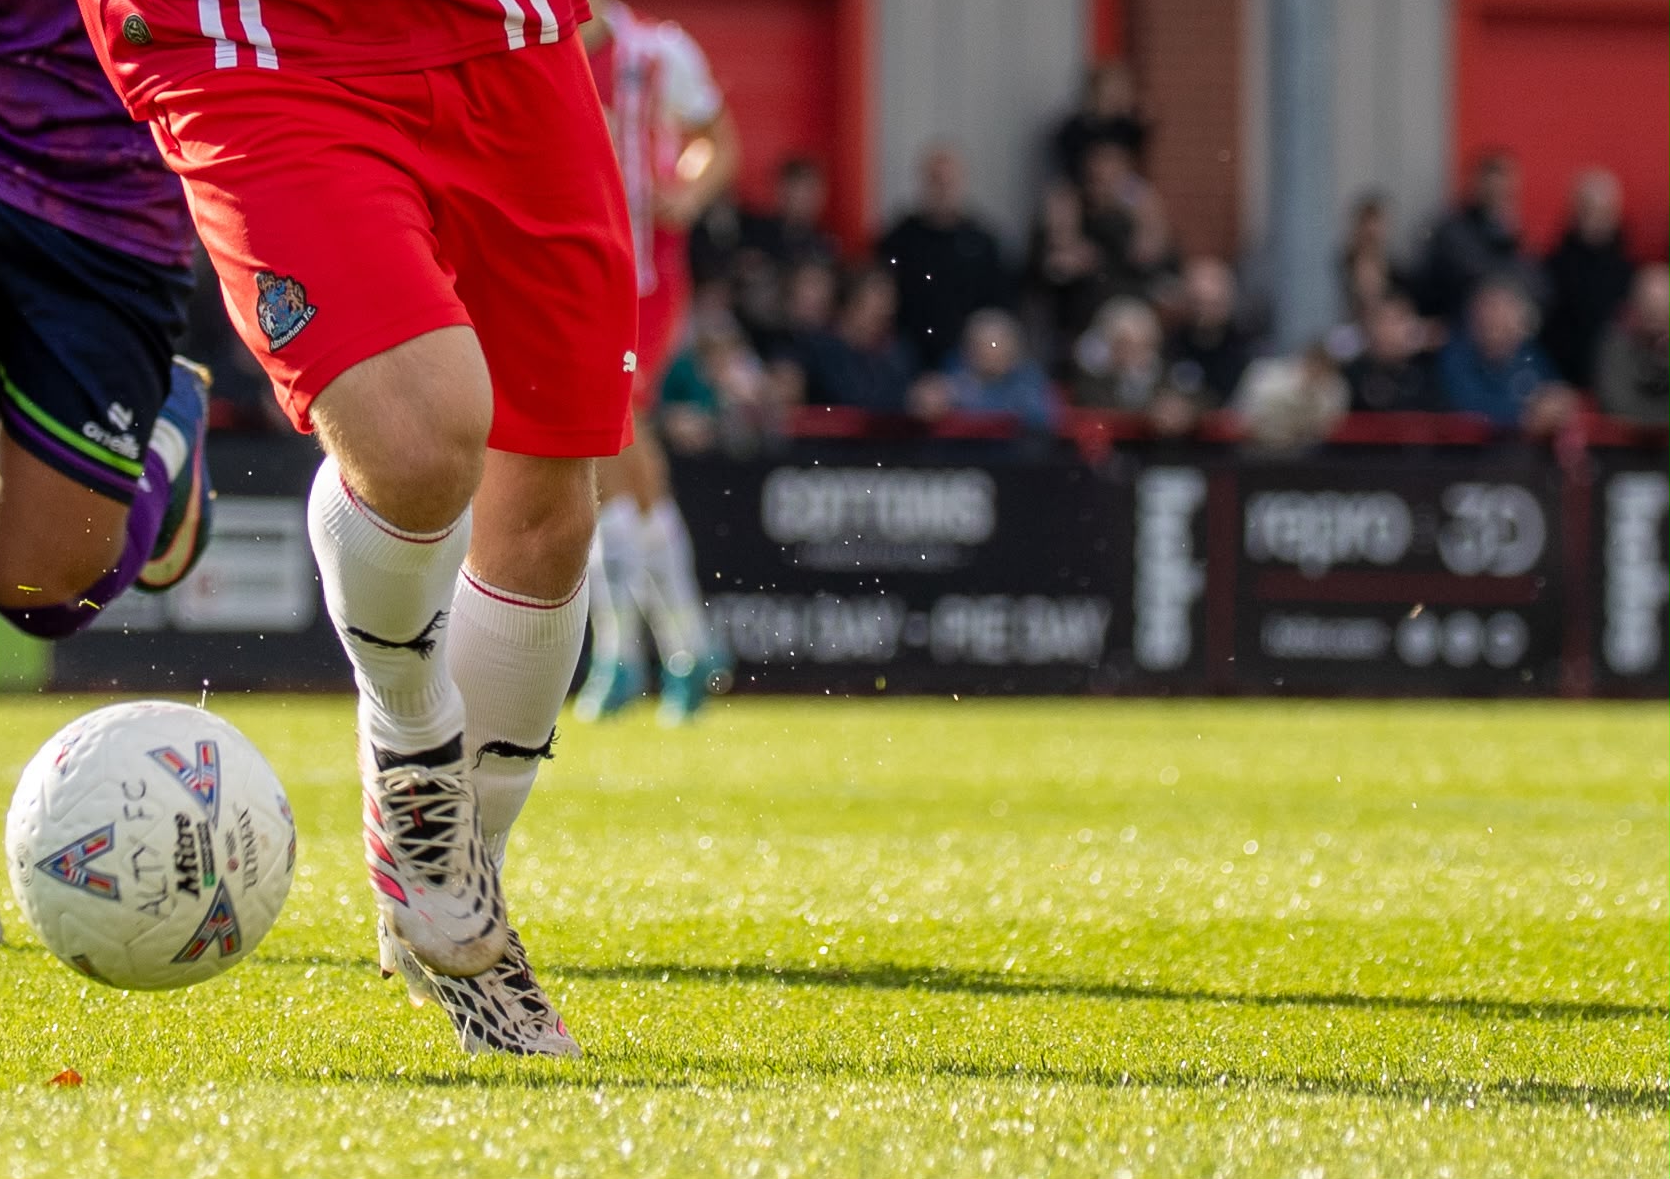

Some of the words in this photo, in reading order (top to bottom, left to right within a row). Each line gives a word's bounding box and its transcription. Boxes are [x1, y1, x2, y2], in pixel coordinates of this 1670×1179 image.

[121, 779, 154, 822] FC
[127, 834, 170, 919] ALTY
[173, 813, 200, 900] Mitre
